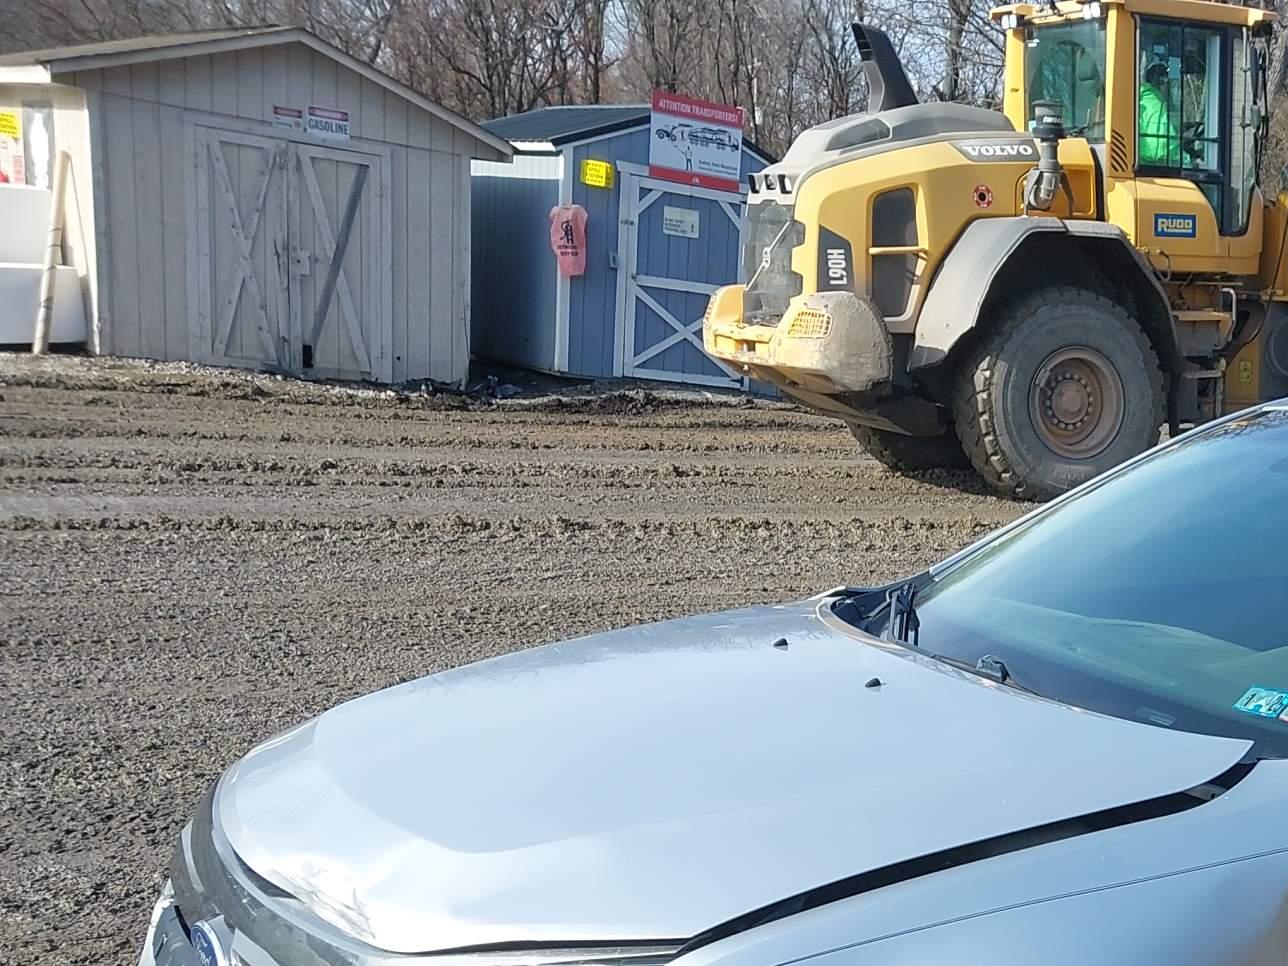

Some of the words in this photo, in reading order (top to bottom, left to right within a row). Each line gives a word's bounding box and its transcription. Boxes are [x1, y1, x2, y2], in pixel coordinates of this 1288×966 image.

[659, 99, 691, 113] ATTENTION
[692, 105, 739, 123] TRANSPORTERS!
[308, 118, 349, 135] GASOLINE
[961, 144, 1033, 156] VOLVO
[1157, 218, 1193, 232] RUDD
[826, 248, 848, 285] L90H
